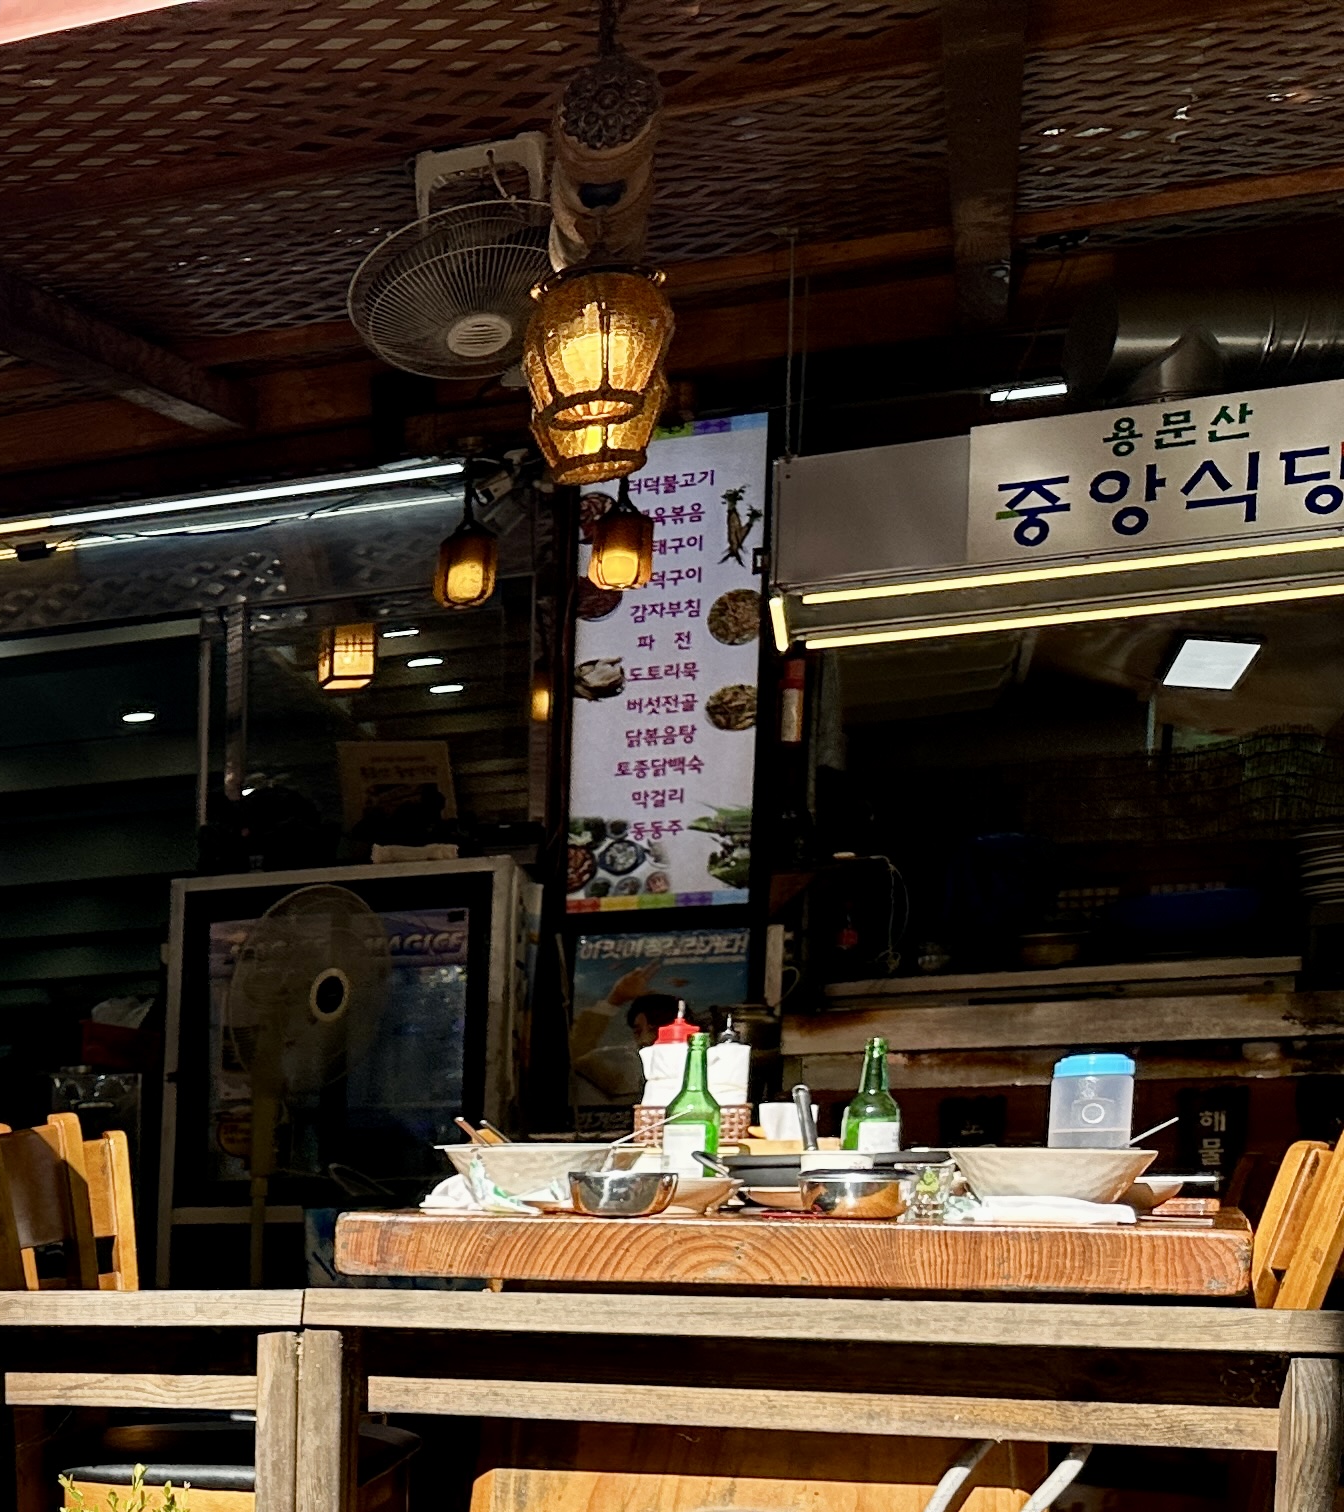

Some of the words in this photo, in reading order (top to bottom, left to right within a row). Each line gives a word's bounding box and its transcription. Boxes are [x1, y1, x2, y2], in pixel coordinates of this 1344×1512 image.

[1102, 402, 1253, 457] 용문산
[996, 442, 1344, 547] 중앙식당
[642, 502, 706, 526] 육볶음
[651, 535, 704, 556] 태구이
[644, 566, 703, 590] 덕구이
[629, 599, 701, 624] 감자부침
[626, 661, 700, 682] 도토리묵
[626, 693, 699, 716] 버섯전골
[625, 725, 698, 748] 닭볶음탕
[614, 755, 705, 779] 토종닭백숙
[632, 788, 685, 809] 막걸리
[631, 819, 684, 841] 동동주
